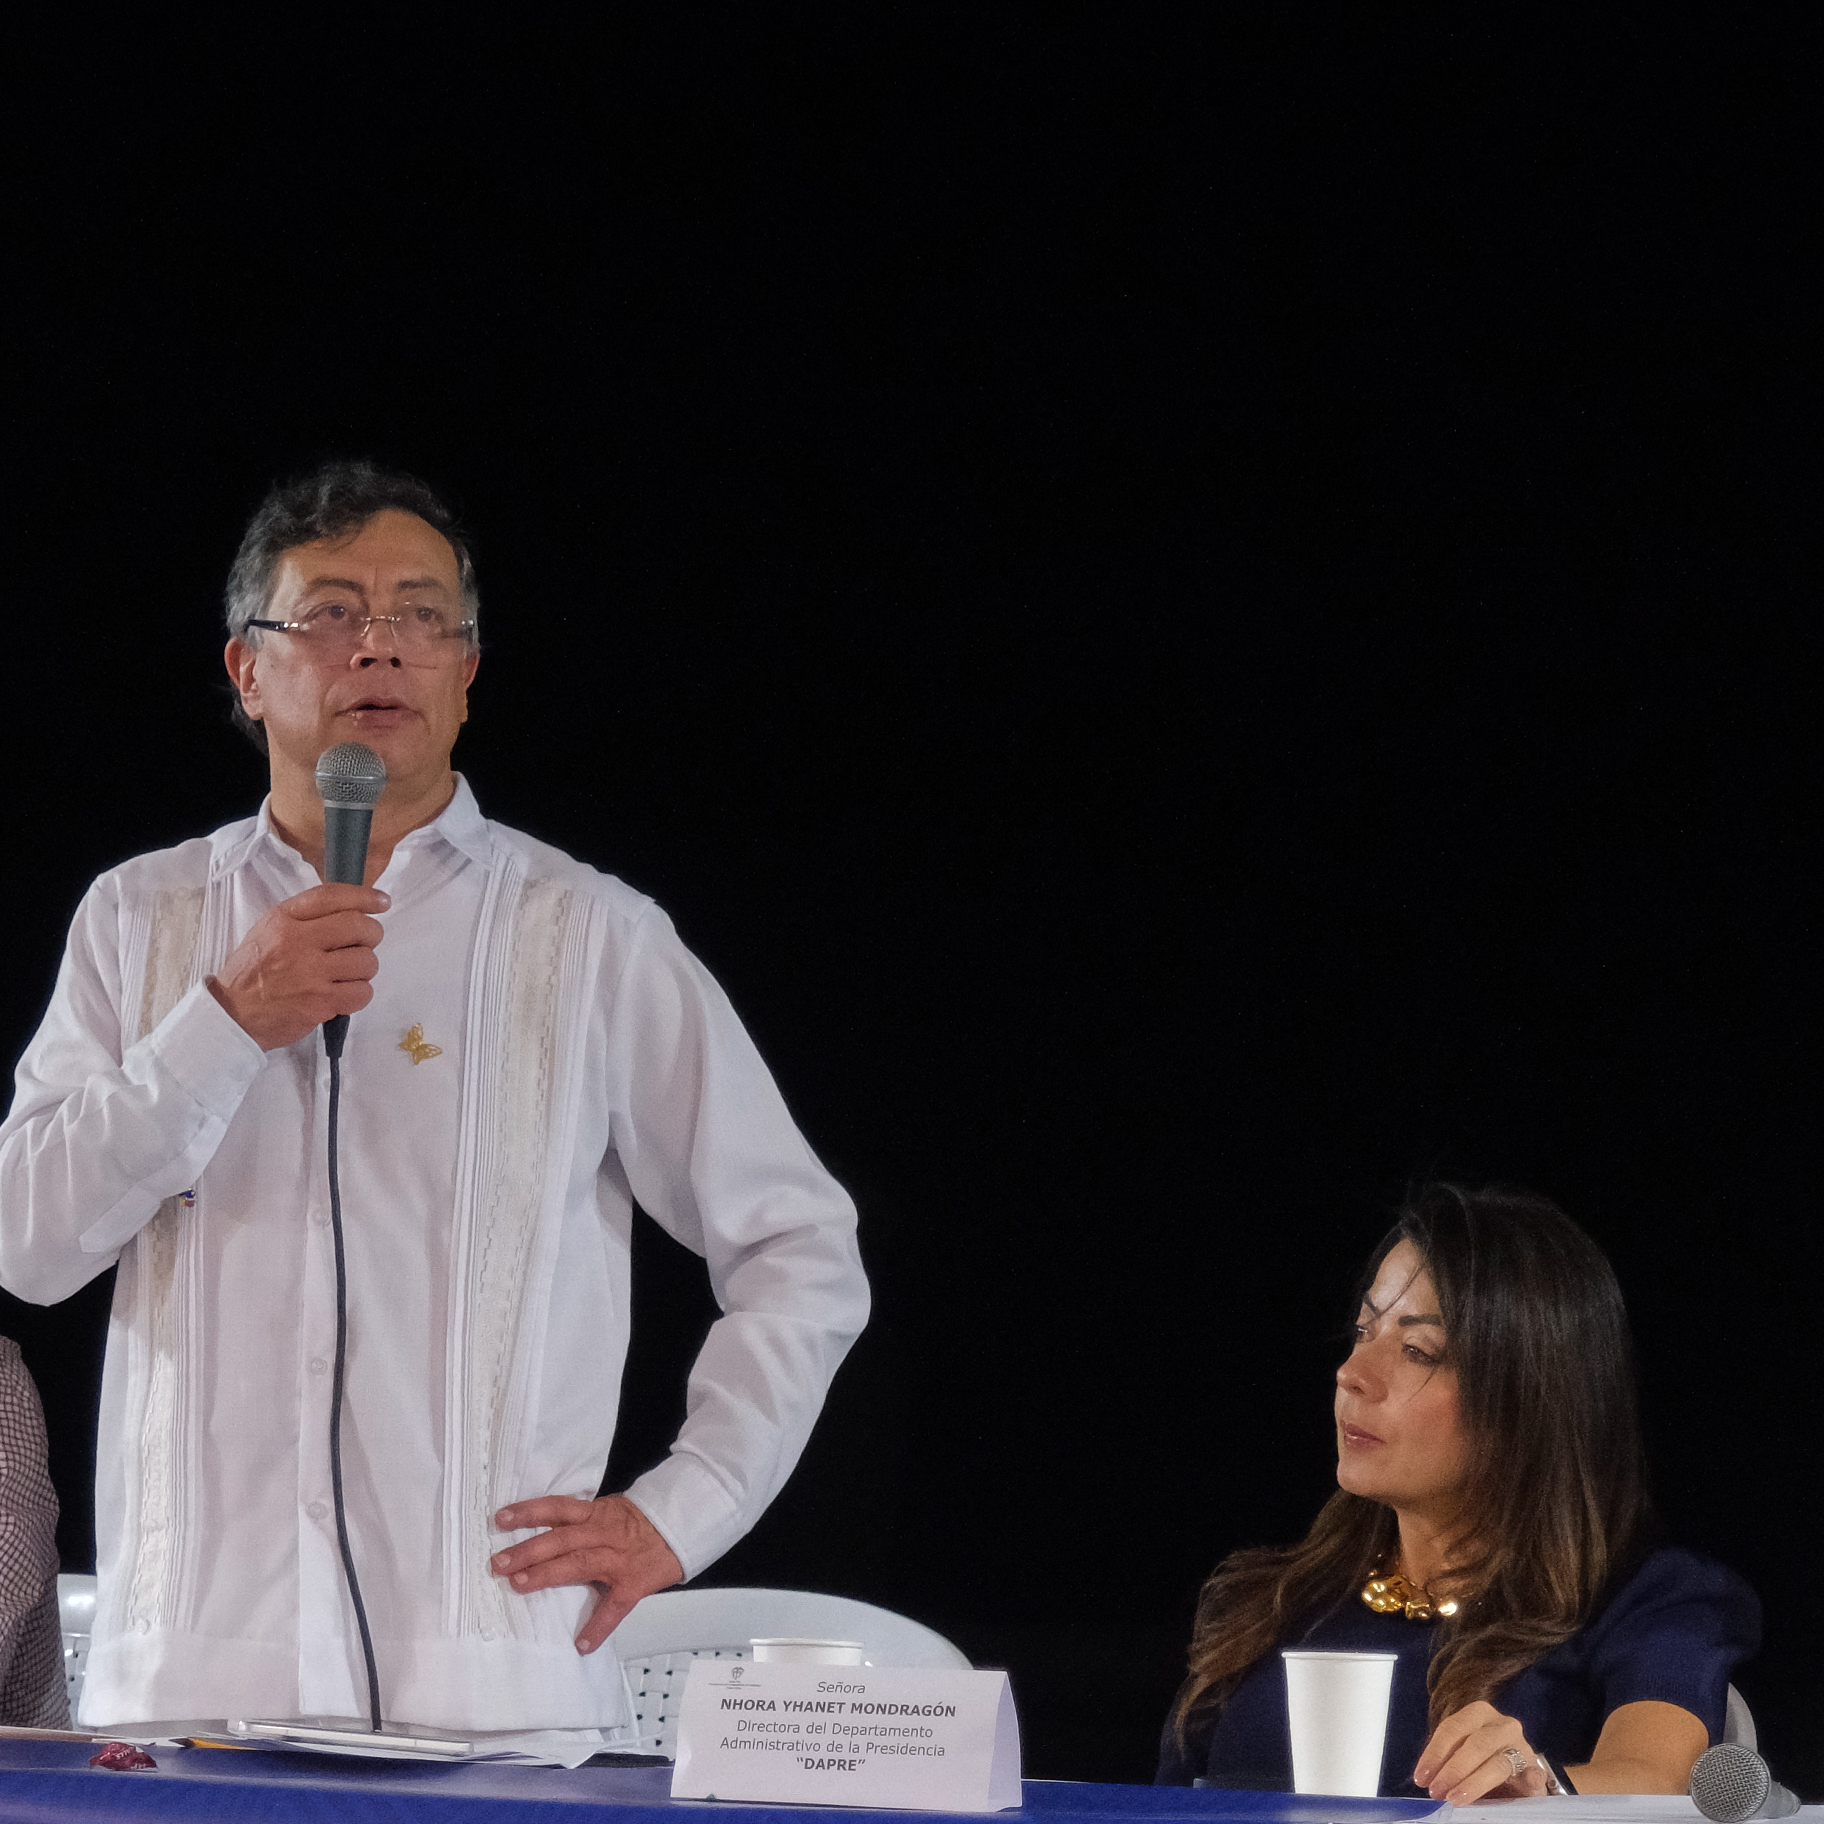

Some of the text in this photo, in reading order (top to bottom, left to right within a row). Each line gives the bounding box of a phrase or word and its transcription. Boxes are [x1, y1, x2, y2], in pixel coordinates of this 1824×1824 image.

[817, 1681, 866, 1695] Señora
[720, 1698, 956, 1718] NHORA YHANET MONDRAGÓN
[736, 1720, 933, 1740] Directora del Departamento
[720, 1738, 946, 1757] Administrativo de la Presidencia
